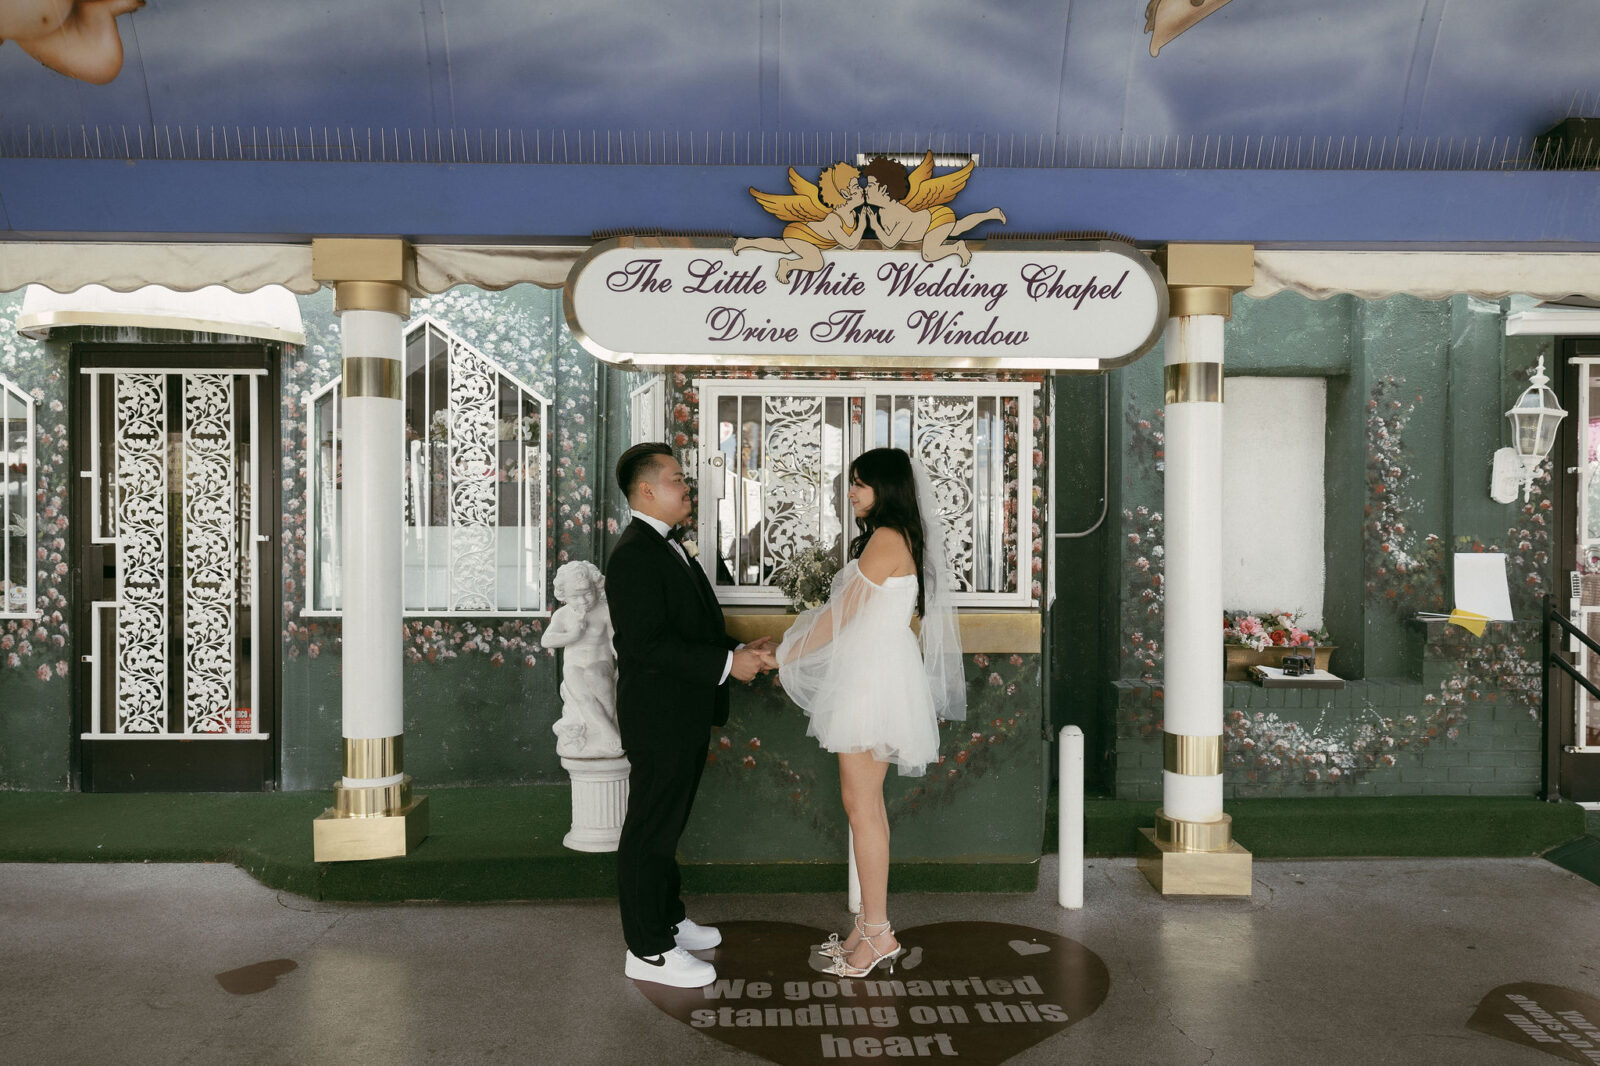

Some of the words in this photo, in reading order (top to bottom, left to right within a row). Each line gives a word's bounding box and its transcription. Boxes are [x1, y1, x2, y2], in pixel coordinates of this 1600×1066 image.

[606, 259, 672, 293] The
[683, 259, 766, 294] Little
[786, 262, 866, 295] White
[877, 262, 1007, 311] Wedding
[1021, 263, 1130, 310] Chapel
[706, 307, 799, 343] Drive
[810, 310, 896, 344] Thru
[907, 310, 1029, 346] Window
[702, 979, 772, 999] We
[783, 978, 857, 1000] got
[865, 976, 1044, 997] married
[690, 1004, 900, 1028] standing
[909, 1005, 970, 1024] on
[974, 1001, 1069, 1022] this
[820, 1033, 959, 1058] heart
